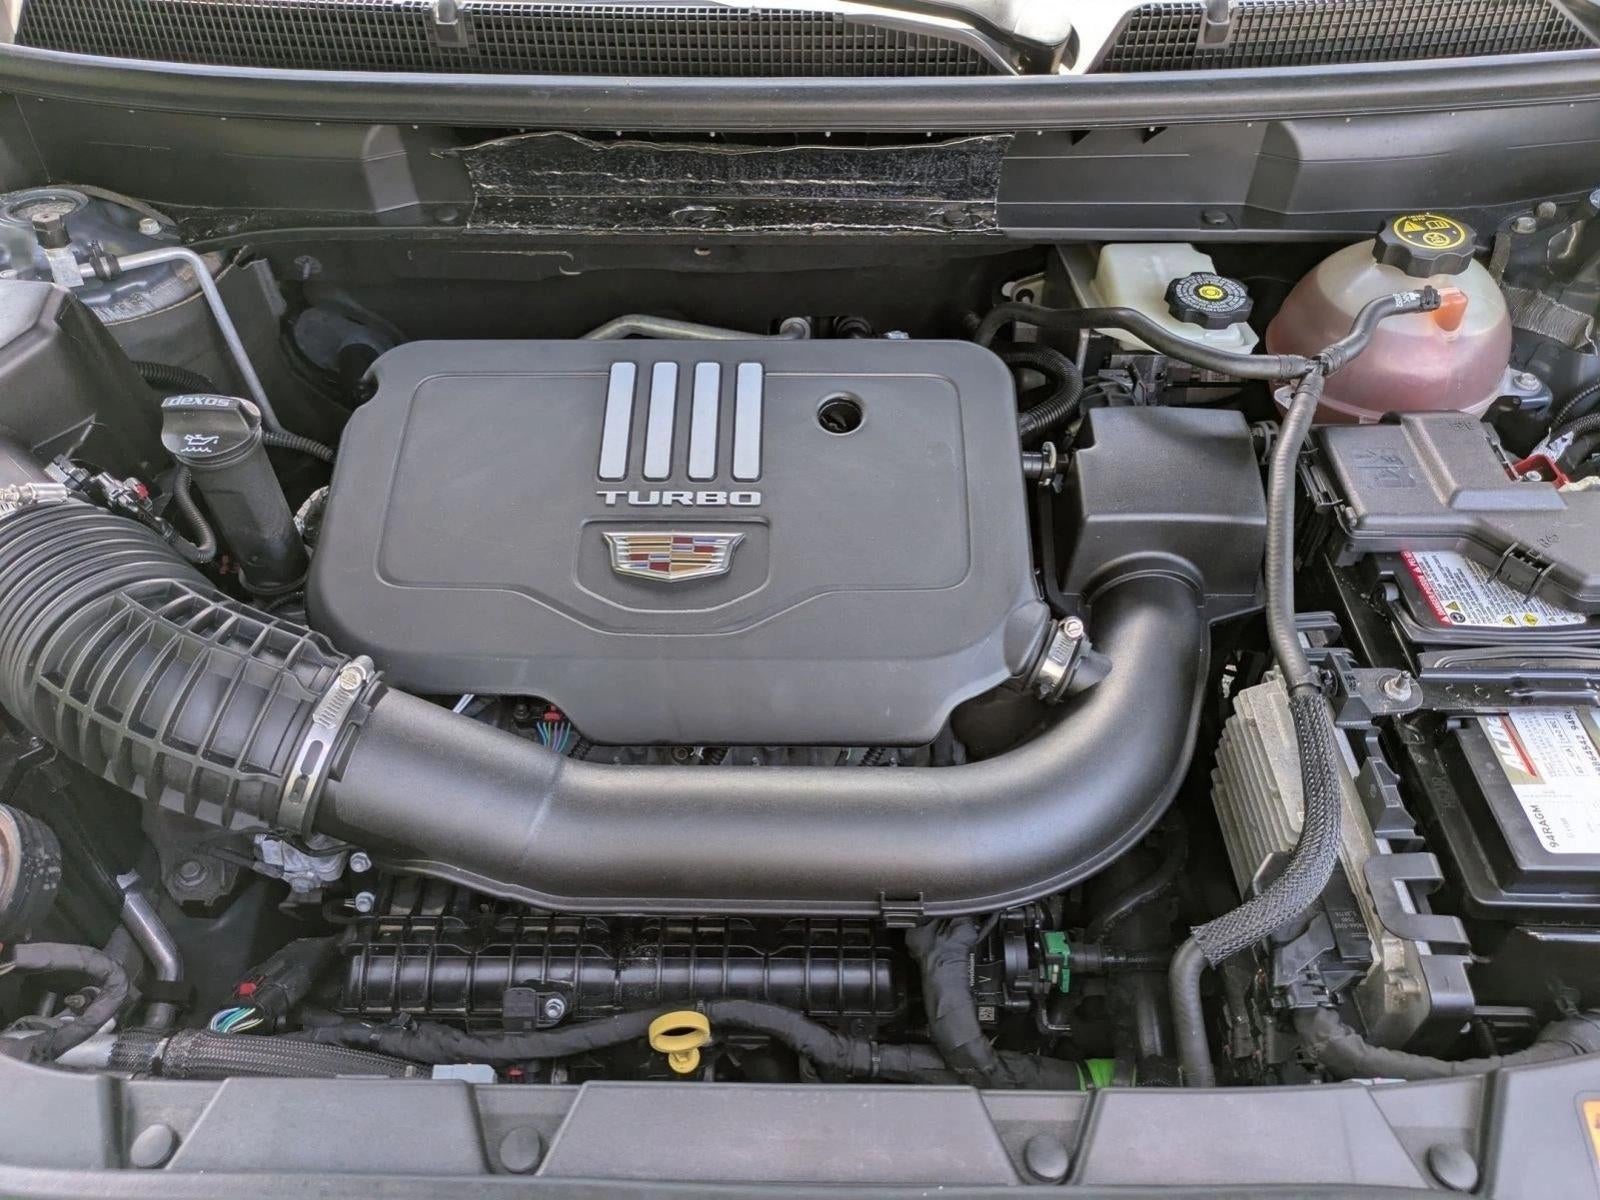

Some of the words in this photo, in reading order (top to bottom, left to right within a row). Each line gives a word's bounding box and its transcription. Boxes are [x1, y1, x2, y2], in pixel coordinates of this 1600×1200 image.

[168, 396, 231, 407] dexos
[596, 490, 762, 506] TURBO
[1530, 804, 1560, 848] 94RAGM
